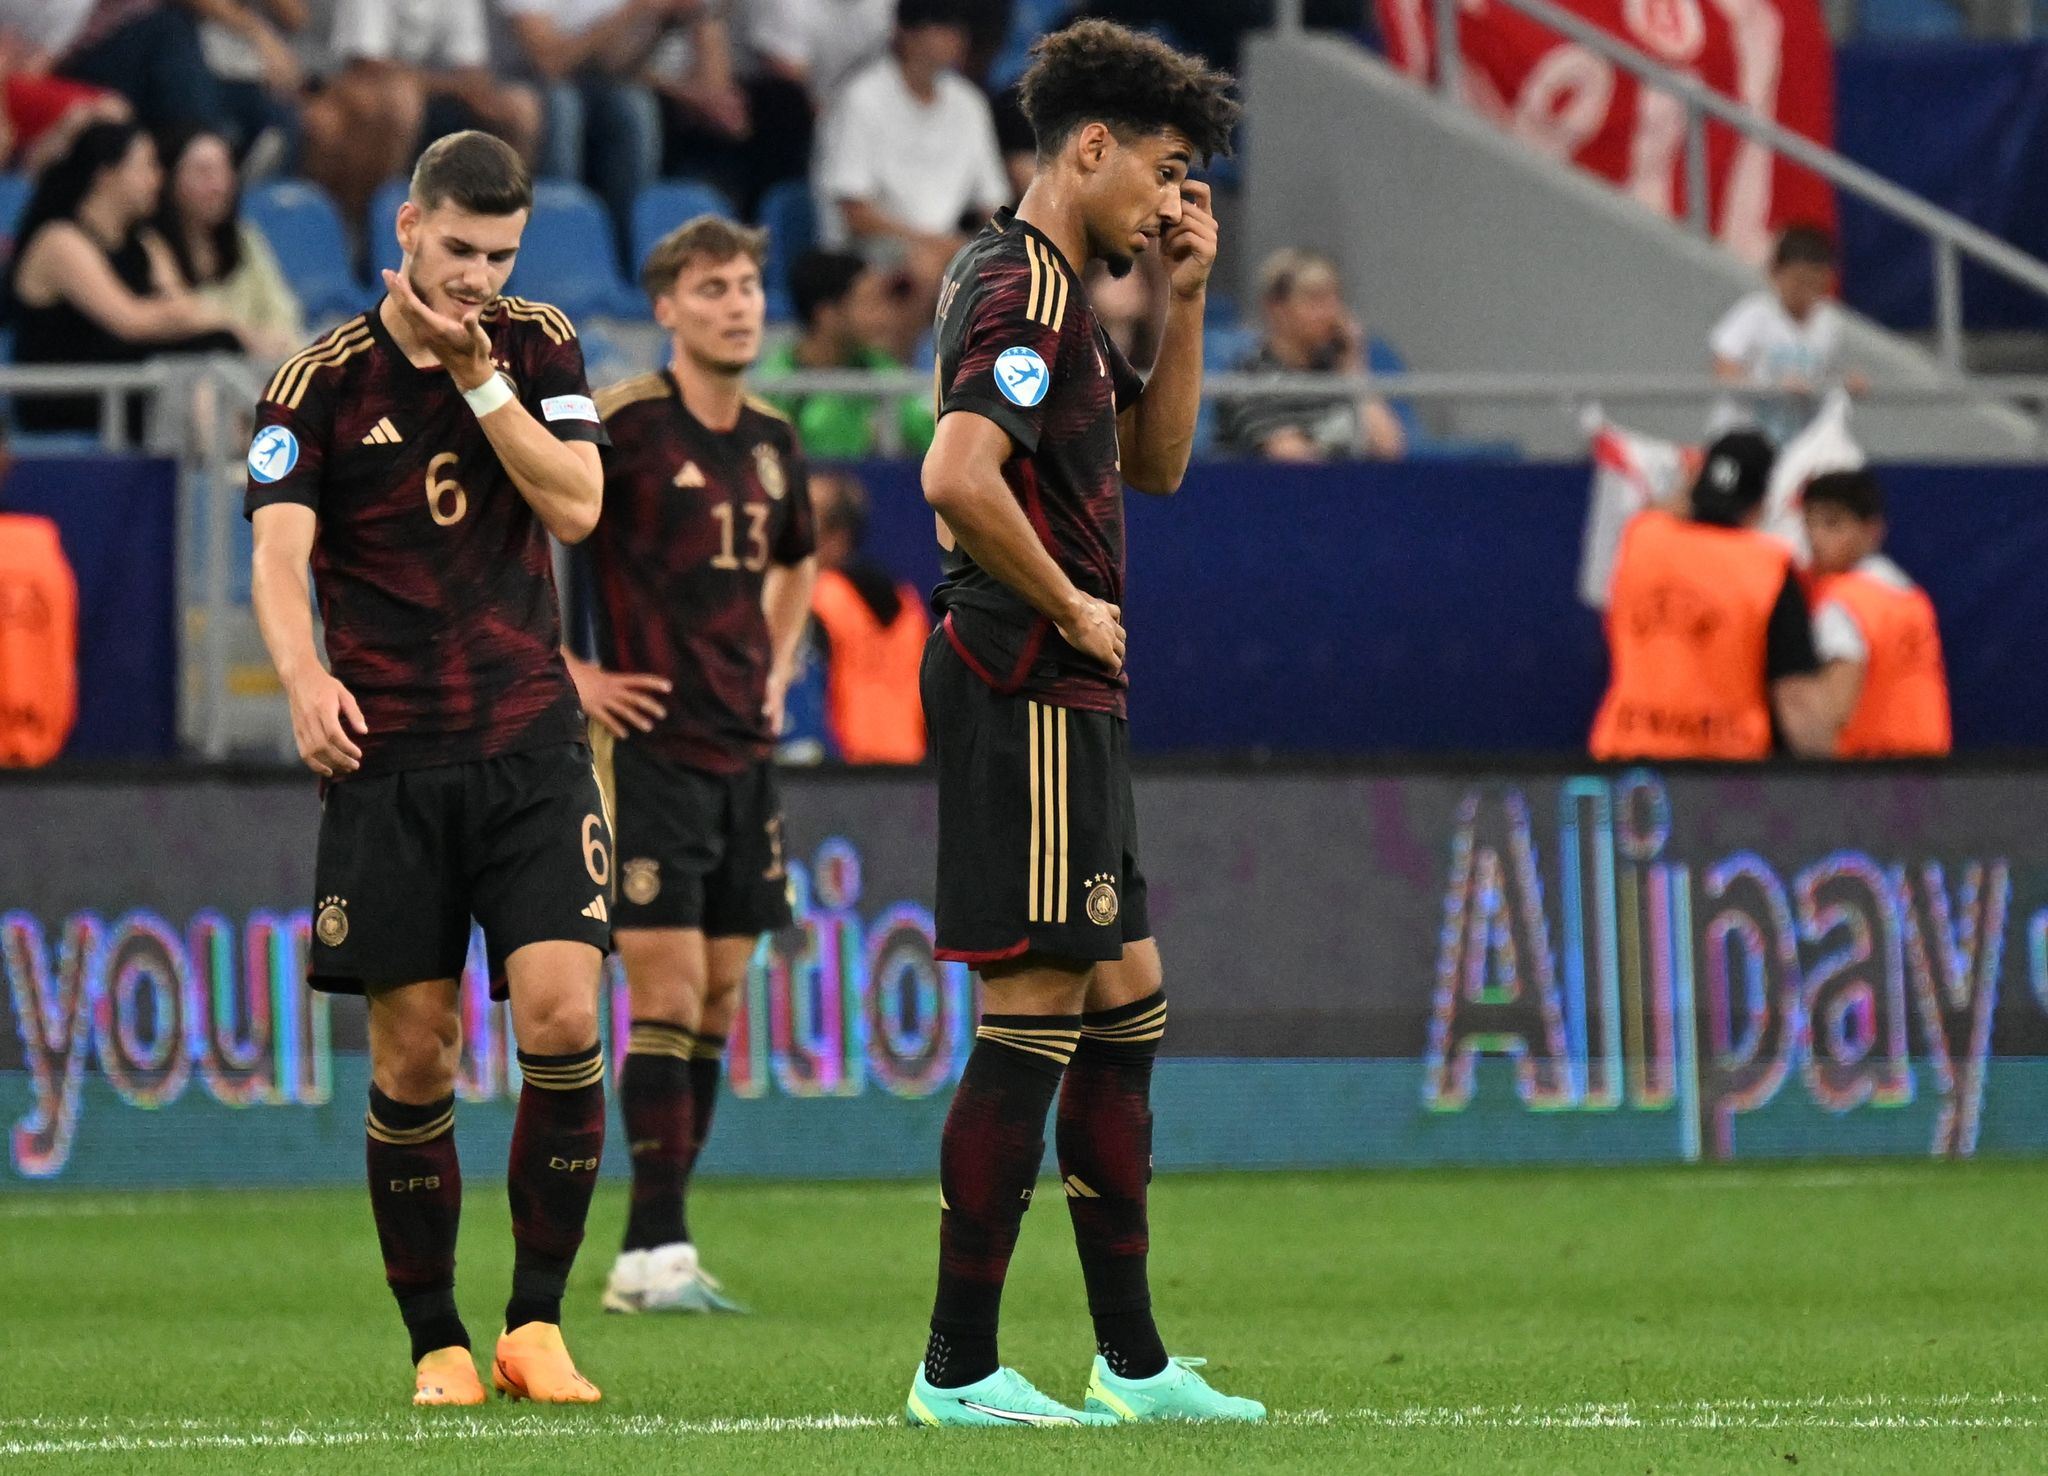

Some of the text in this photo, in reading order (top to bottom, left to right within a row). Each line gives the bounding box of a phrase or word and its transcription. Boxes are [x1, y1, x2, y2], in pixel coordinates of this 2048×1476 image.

[425, 452, 467, 526] 6
[711, 501, 769, 572] 13
[582, 813, 609, 886] 6
[1424, 767, 2010, 1161] Alipay
[390, 1176, 440, 1192] DFB
[549, 1157, 597, 1172] DFB
